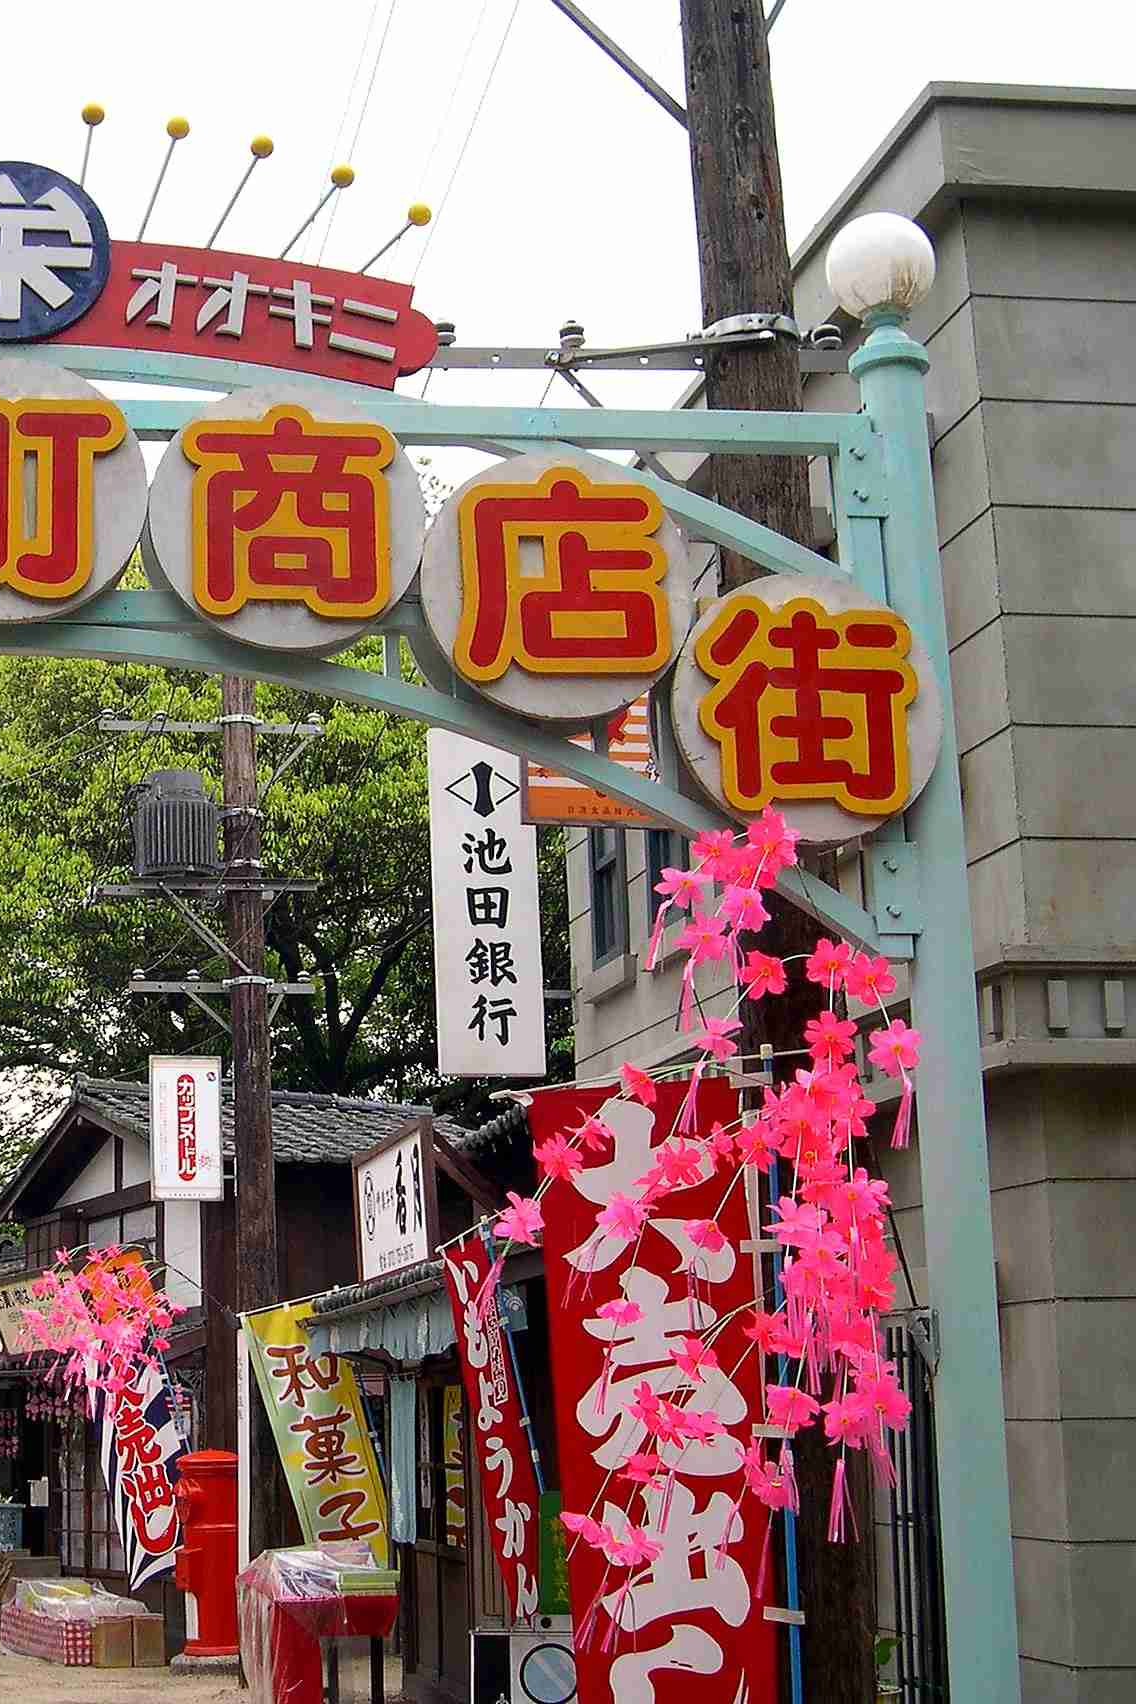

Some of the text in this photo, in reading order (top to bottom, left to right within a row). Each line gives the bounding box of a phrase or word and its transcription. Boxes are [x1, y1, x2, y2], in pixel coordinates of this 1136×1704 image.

[130, 260, 399, 360] オオキニ
[462, 827, 519, 1047] 池田銀行
[177, 1081, 197, 1176] カップヌードル
[264, 1343, 382, 1543] 和菓子
[444, 1256, 539, 1620] いもようかん
